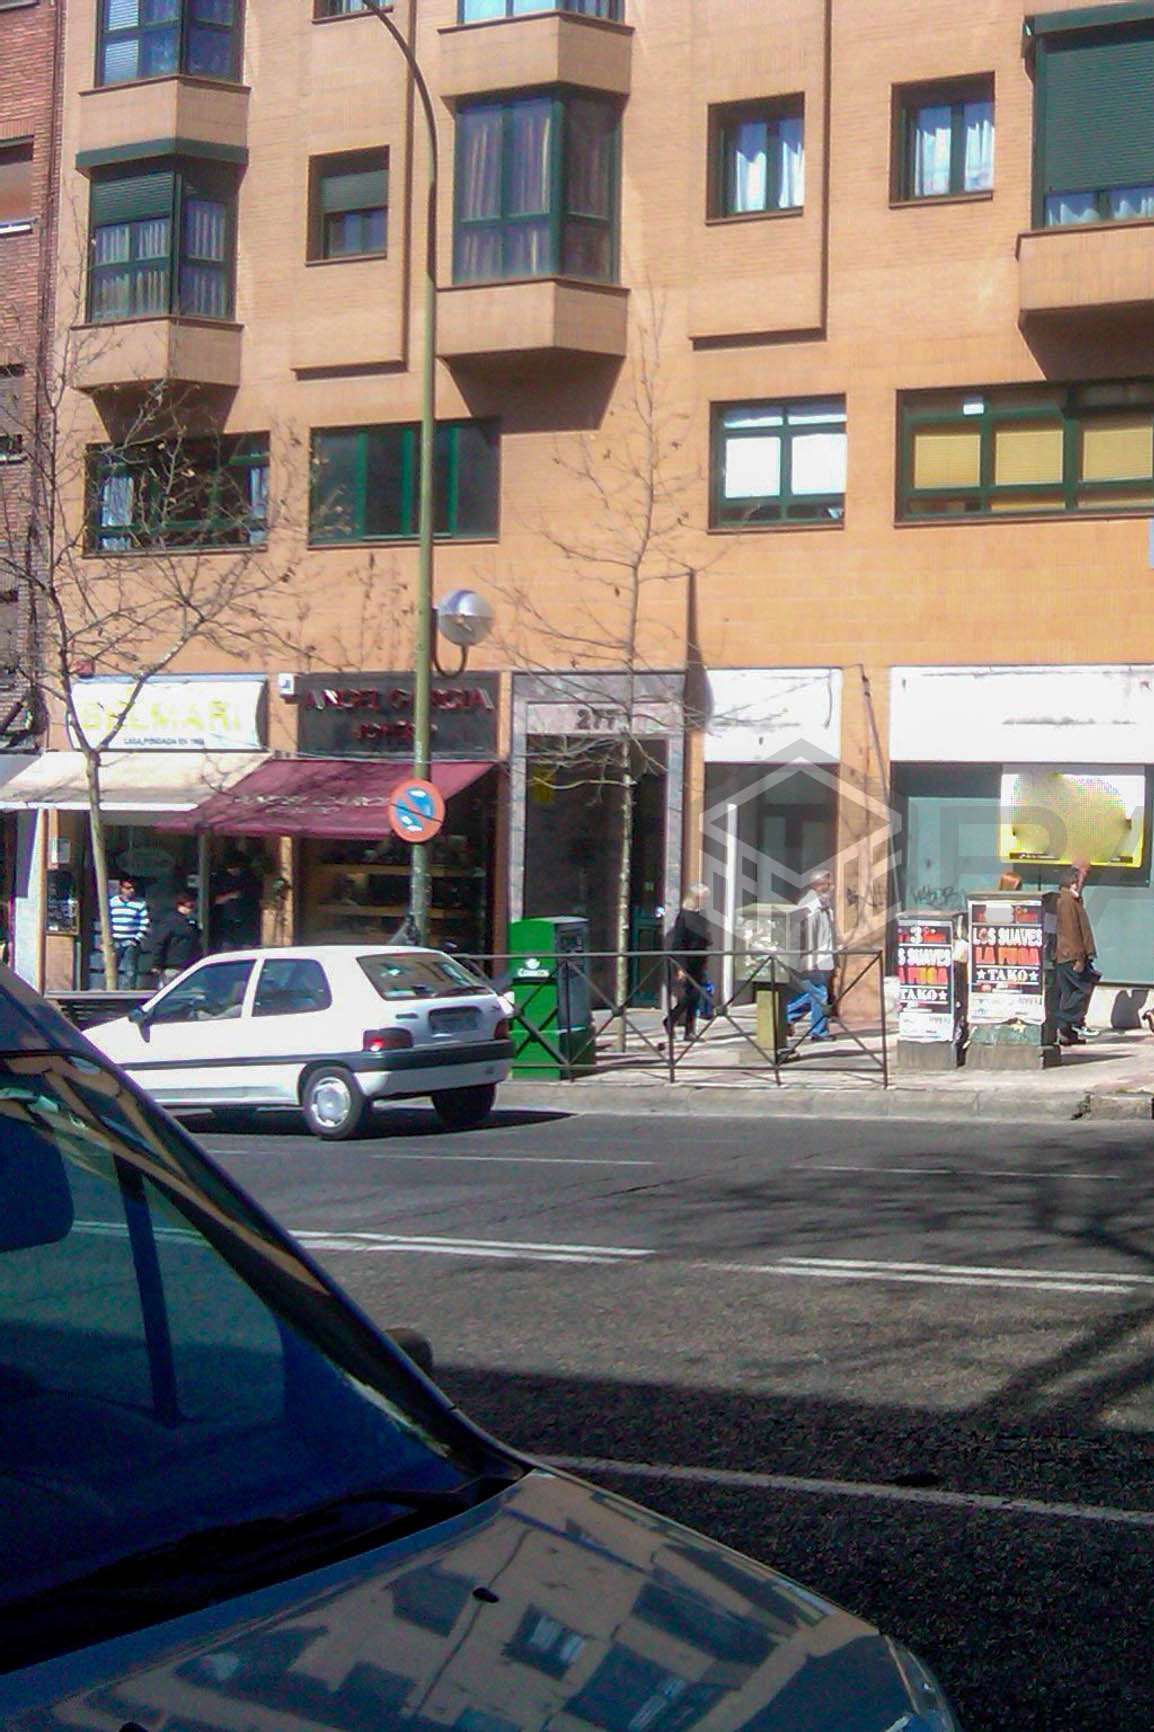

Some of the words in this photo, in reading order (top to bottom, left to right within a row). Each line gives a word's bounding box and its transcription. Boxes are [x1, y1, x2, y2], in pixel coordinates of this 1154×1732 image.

[390, 688, 496, 711] GRCIA
[973, 927, 996, 946] LOS
[998, 927, 1043, 947] SUAVES
[975, 946, 996, 965] LA
[987, 969, 1028, 982] TAKO
[901, 988, 938, 1001] TAKO
